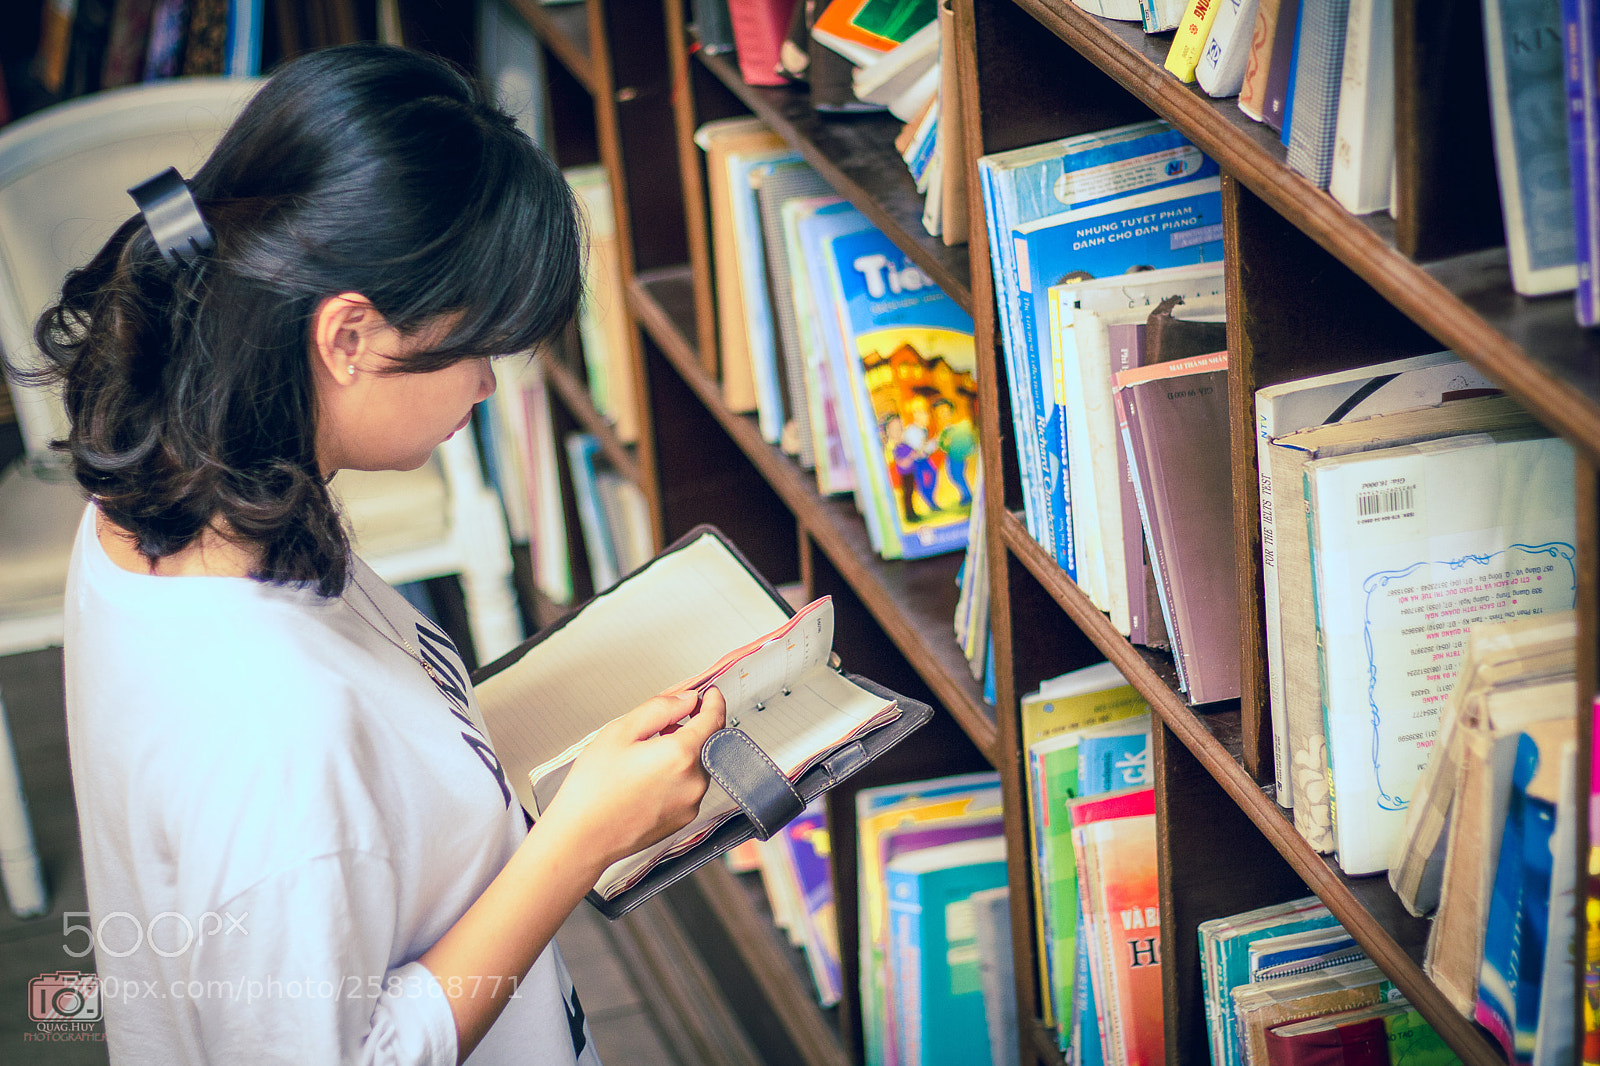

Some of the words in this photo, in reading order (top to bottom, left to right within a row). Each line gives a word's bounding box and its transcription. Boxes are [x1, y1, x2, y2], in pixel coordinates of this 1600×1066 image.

[1162, 217, 1197, 230] PIANO
[1036, 414, 1050, 472] Richard
[1261, 473, 1272, 496] TEST
[1262, 499, 1272, 525] IELTS
[1263, 528, 1273, 546] THE
[1264, 549, 1274, 567] FOR
[1120, 905, 1145, 931] VÀ
